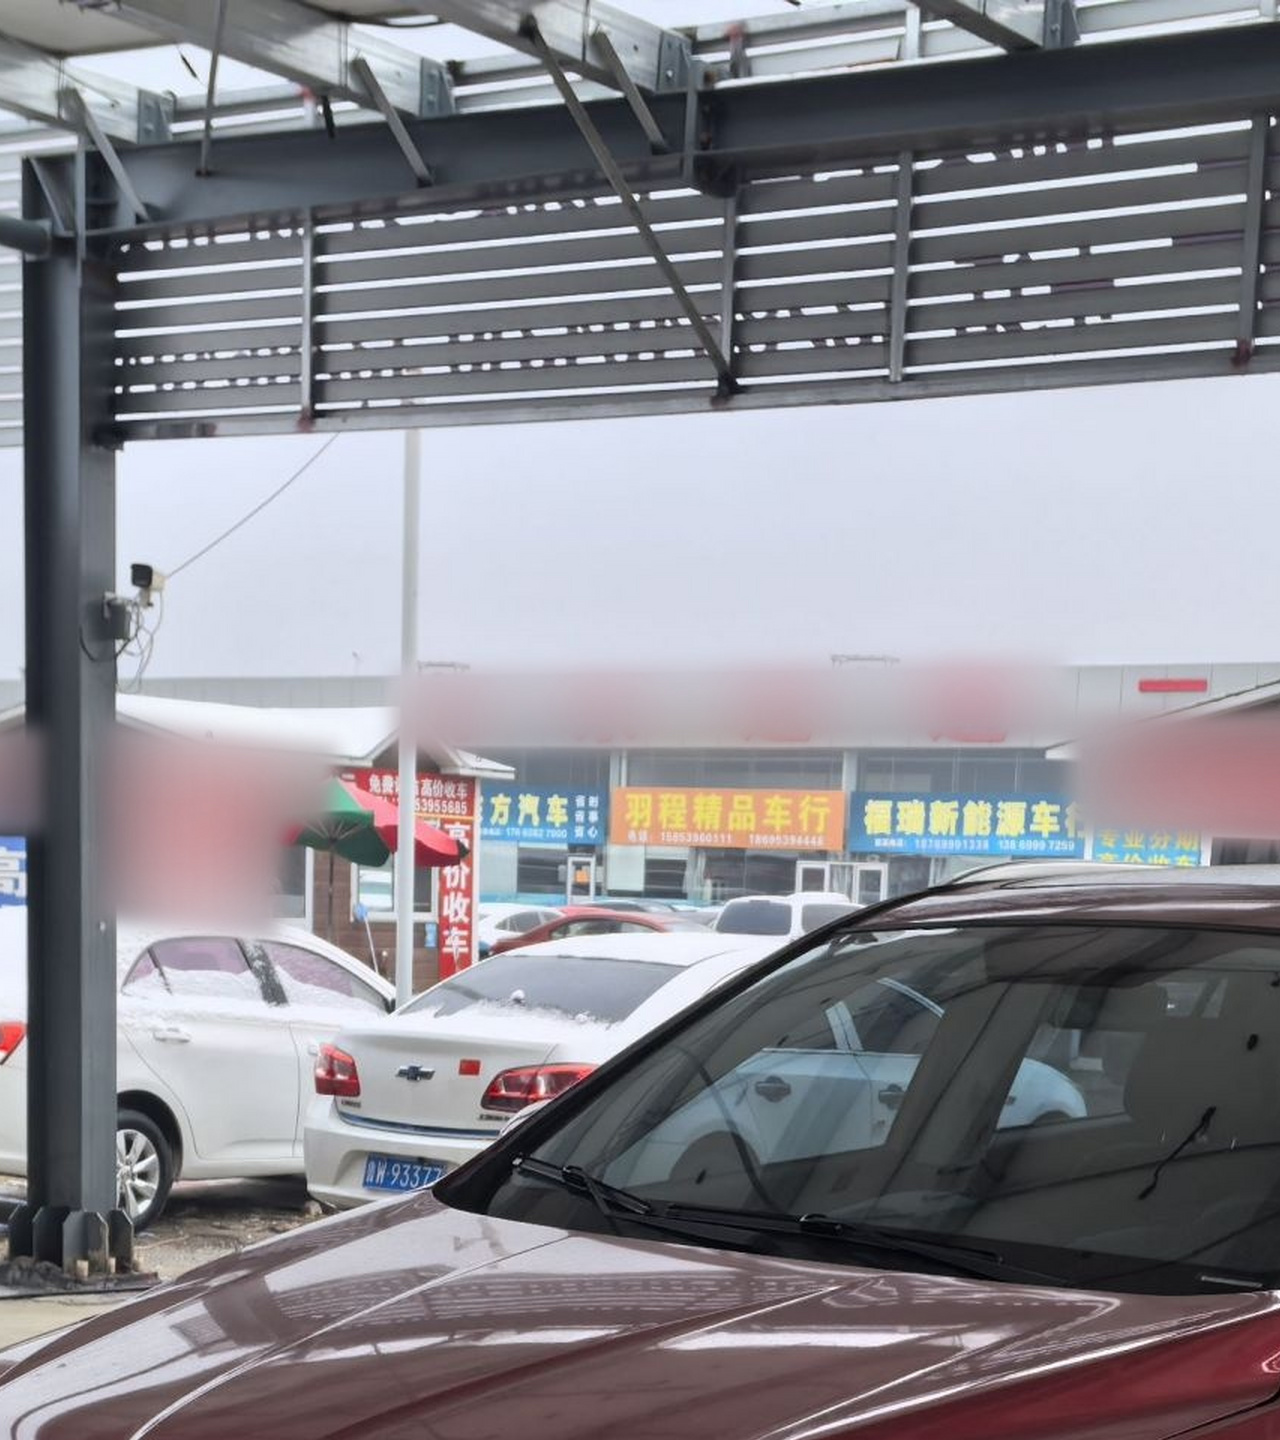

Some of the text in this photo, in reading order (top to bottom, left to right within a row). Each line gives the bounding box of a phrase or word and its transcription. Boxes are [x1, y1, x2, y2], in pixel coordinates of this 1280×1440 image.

[625, 792, 831, 834] 羽程精品车行
